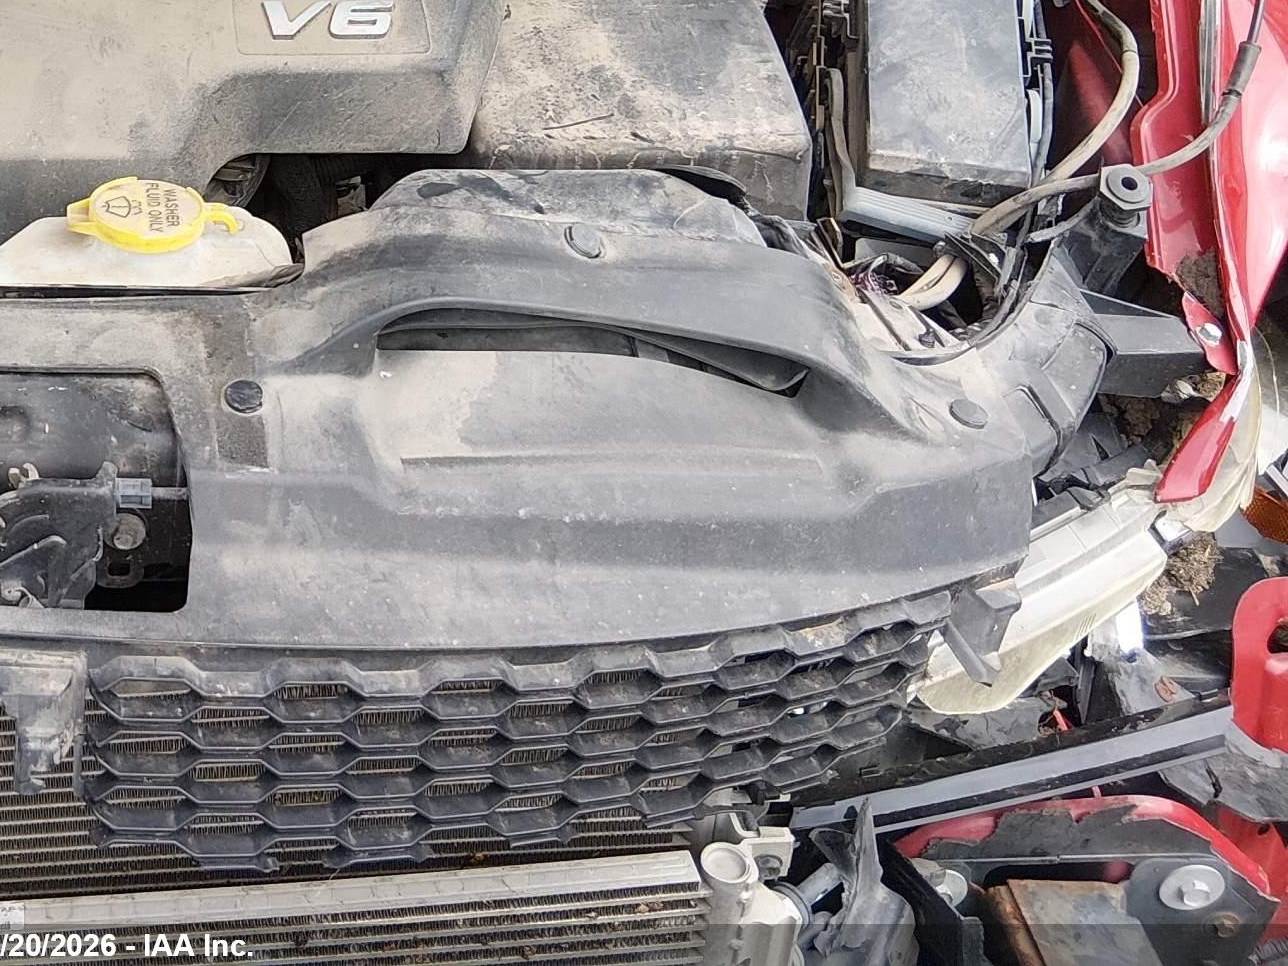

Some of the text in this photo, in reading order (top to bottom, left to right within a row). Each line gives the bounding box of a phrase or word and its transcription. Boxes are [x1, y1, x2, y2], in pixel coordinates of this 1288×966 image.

[262, 0, 394, 40] V6
[145, 182, 164, 233] FLUID ONLY
[162, 188, 181, 227] WASHER
